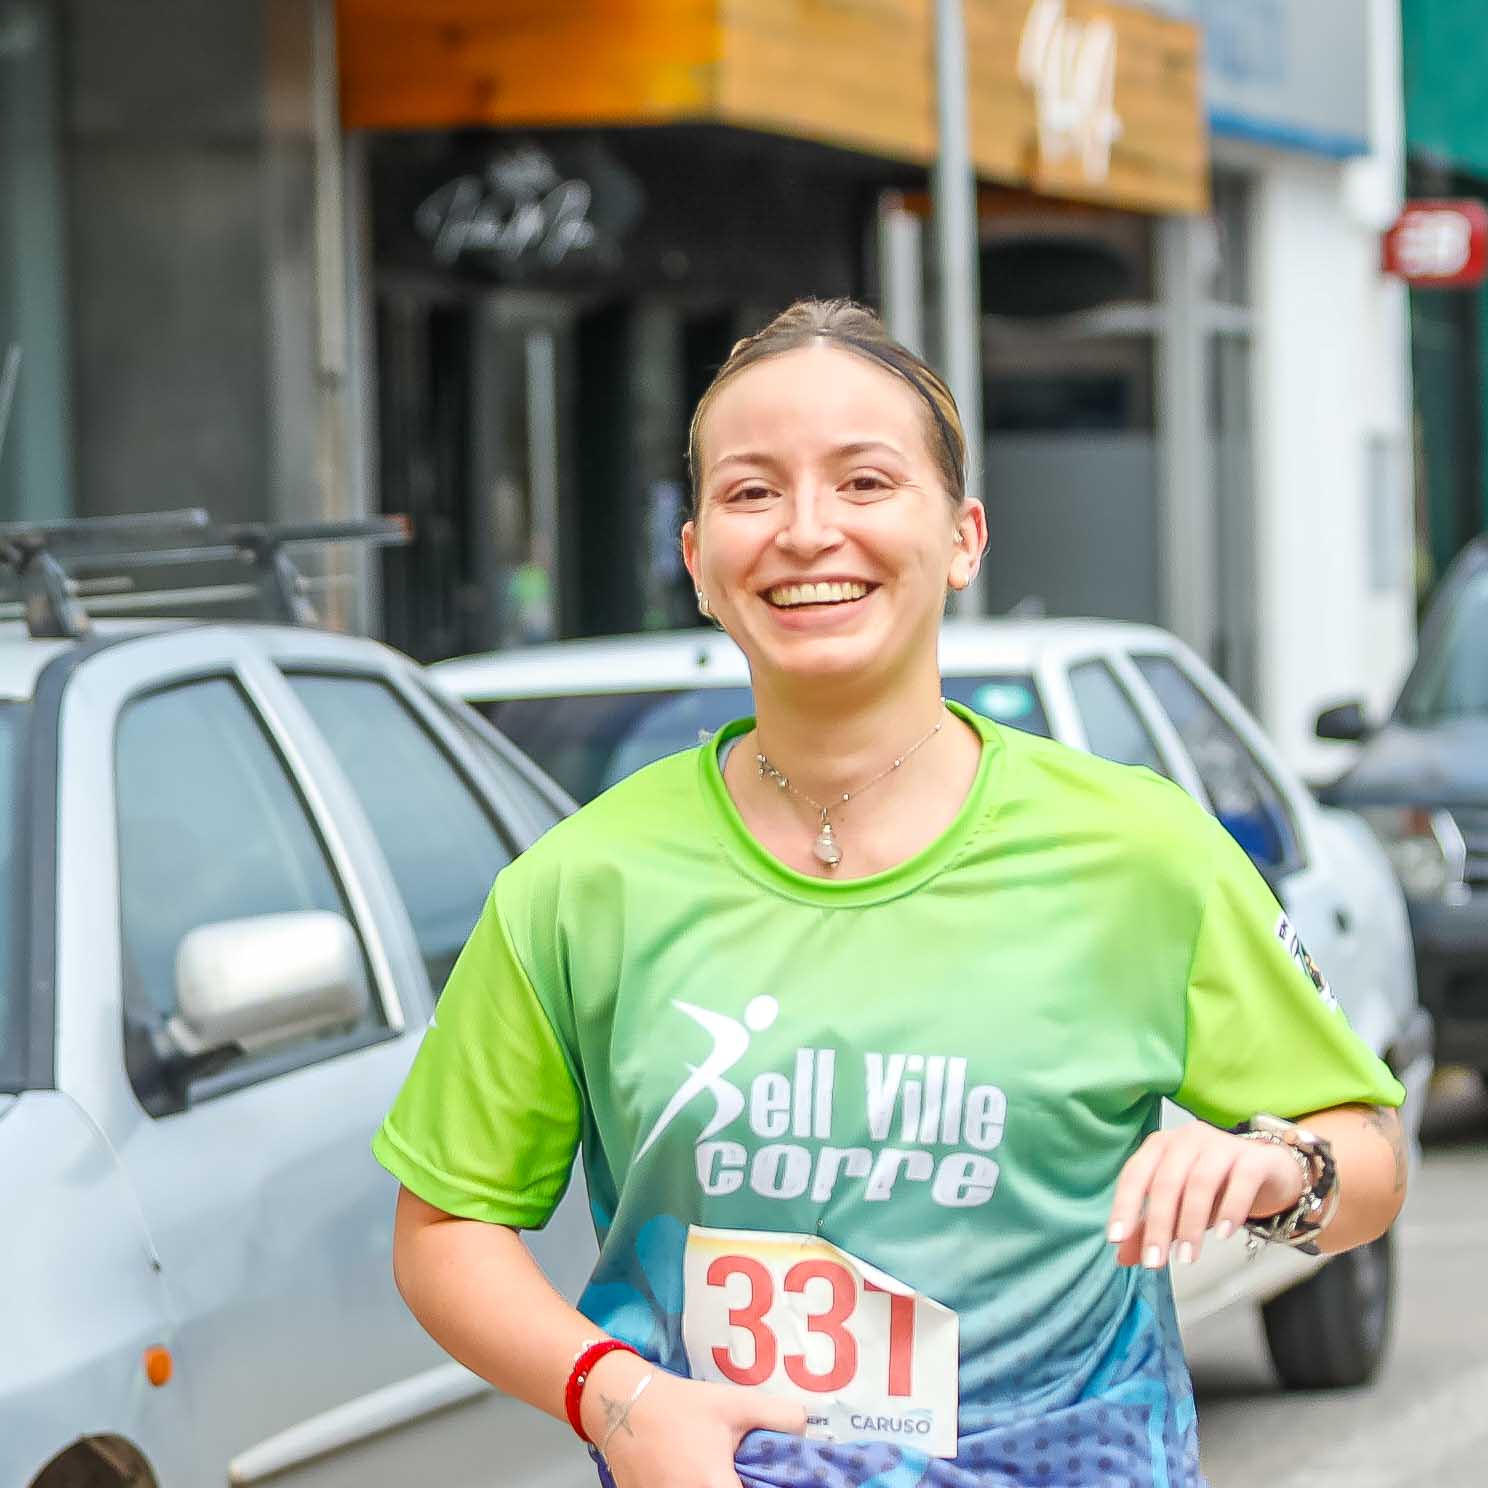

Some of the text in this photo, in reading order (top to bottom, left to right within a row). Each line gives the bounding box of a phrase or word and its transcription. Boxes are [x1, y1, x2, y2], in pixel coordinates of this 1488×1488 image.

[865, 1052, 1007, 1151] Ville
[695, 1140, 1000, 1208] corre
[706, 1254, 916, 1397] 331
[850, 1414, 933, 1435] CARUSO
